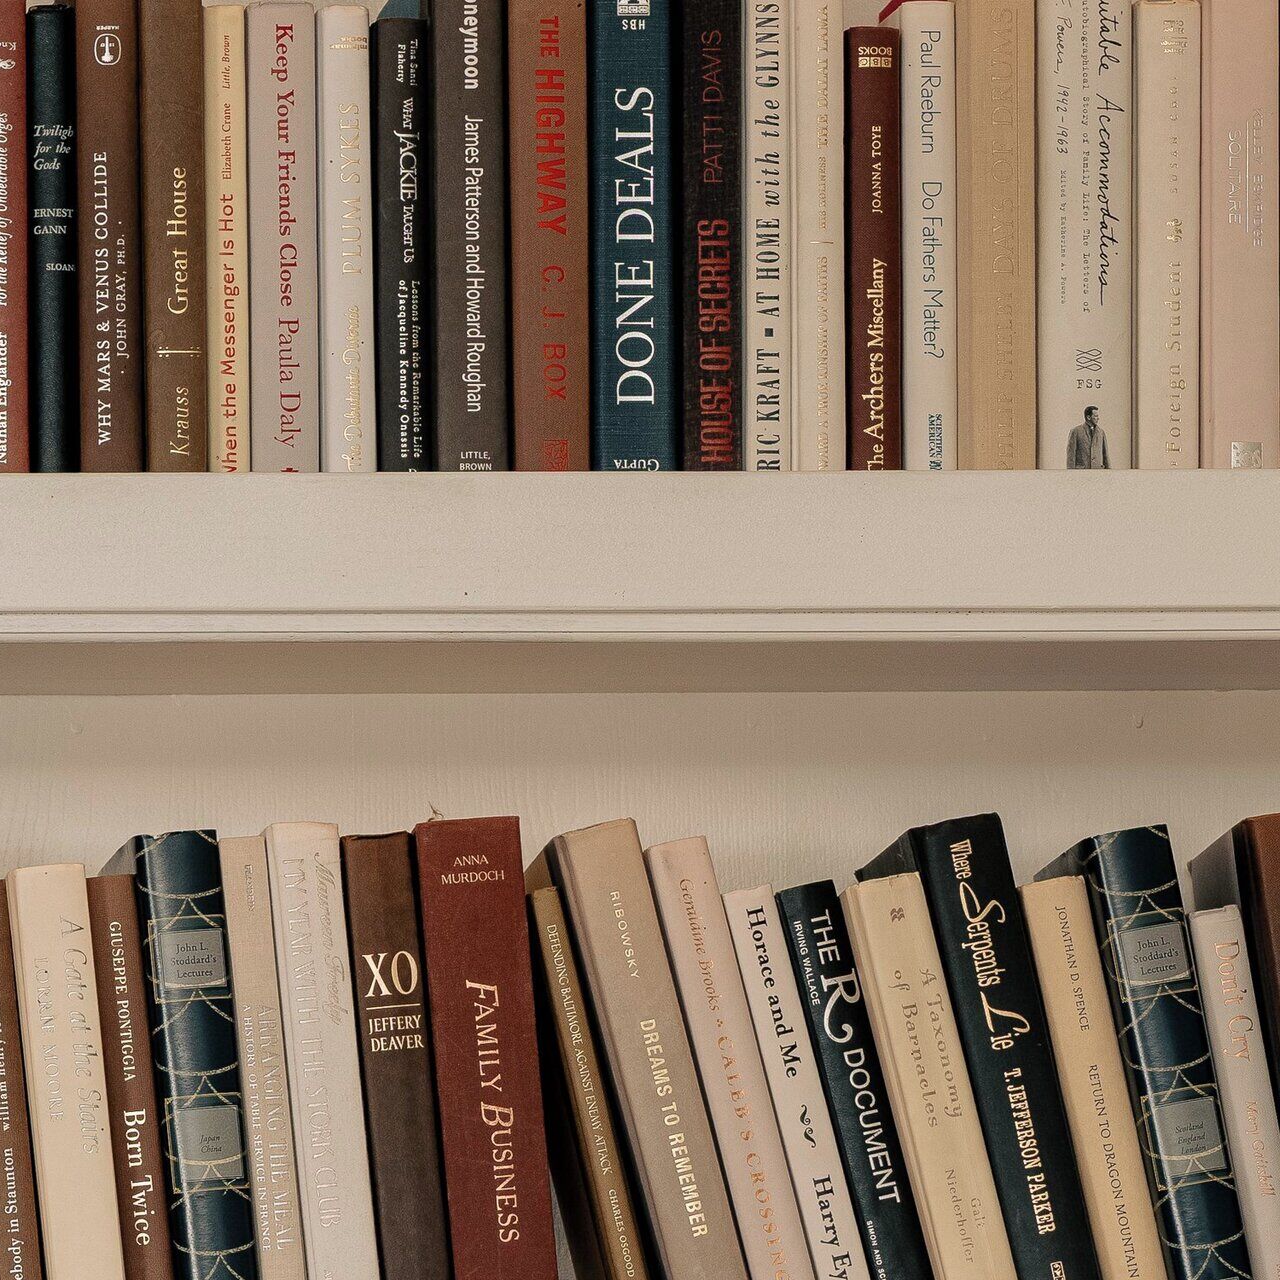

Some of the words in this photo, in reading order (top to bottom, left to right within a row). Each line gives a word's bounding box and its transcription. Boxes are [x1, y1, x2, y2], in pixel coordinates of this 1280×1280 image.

[271, 24, 293, 84] Keep
[919, 30, 940, 67] Paul
[276, 90, 296, 143] Your
[919, 75, 941, 154] Raeburn
[277, 150, 296, 235] Friends
[615, 86, 654, 244] DEALS
[920, 180, 942, 209] Do
[33, 209, 74, 219] ERNEST
[33, 225, 67, 235] GANN
[167, 167, 186, 237] House
[168, 249, 187, 315] Great
[279, 243, 298, 307] Close
[921, 216, 943, 283] Fathers
[278, 319, 301, 385] Paula
[616, 260, 655, 405] DONE
[921, 289, 944, 359] Matter?
[276, 390, 302, 448] Daly
[441, 870, 505, 884] MURDOCH
[453, 854, 489, 866] ANNA
[361, 950, 418, 997] XO
[745, 906, 775, 989] Horace
[793, 920, 809, 959] IRVING
[803, 958, 821, 1006] WALLACE
[369, 1015, 421, 1034] JEFFERY
[370, 1033, 424, 1052] DEAVER
[466, 979, 503, 1092] FAMILY
[768, 994, 794, 1038] and
[641, 1019, 672, 1096] DREAMS
[779, 1041, 802, 1079] Me
[124, 1107, 147, 1170] Born
[661, 1102, 681, 1126] TO
[481, 1101, 519, 1243] BUSINESS
[669, 1133, 708, 1238] REMEMBER
[130, 1176, 153, 1247] Twice
[812, 1175, 840, 1247] Harry
